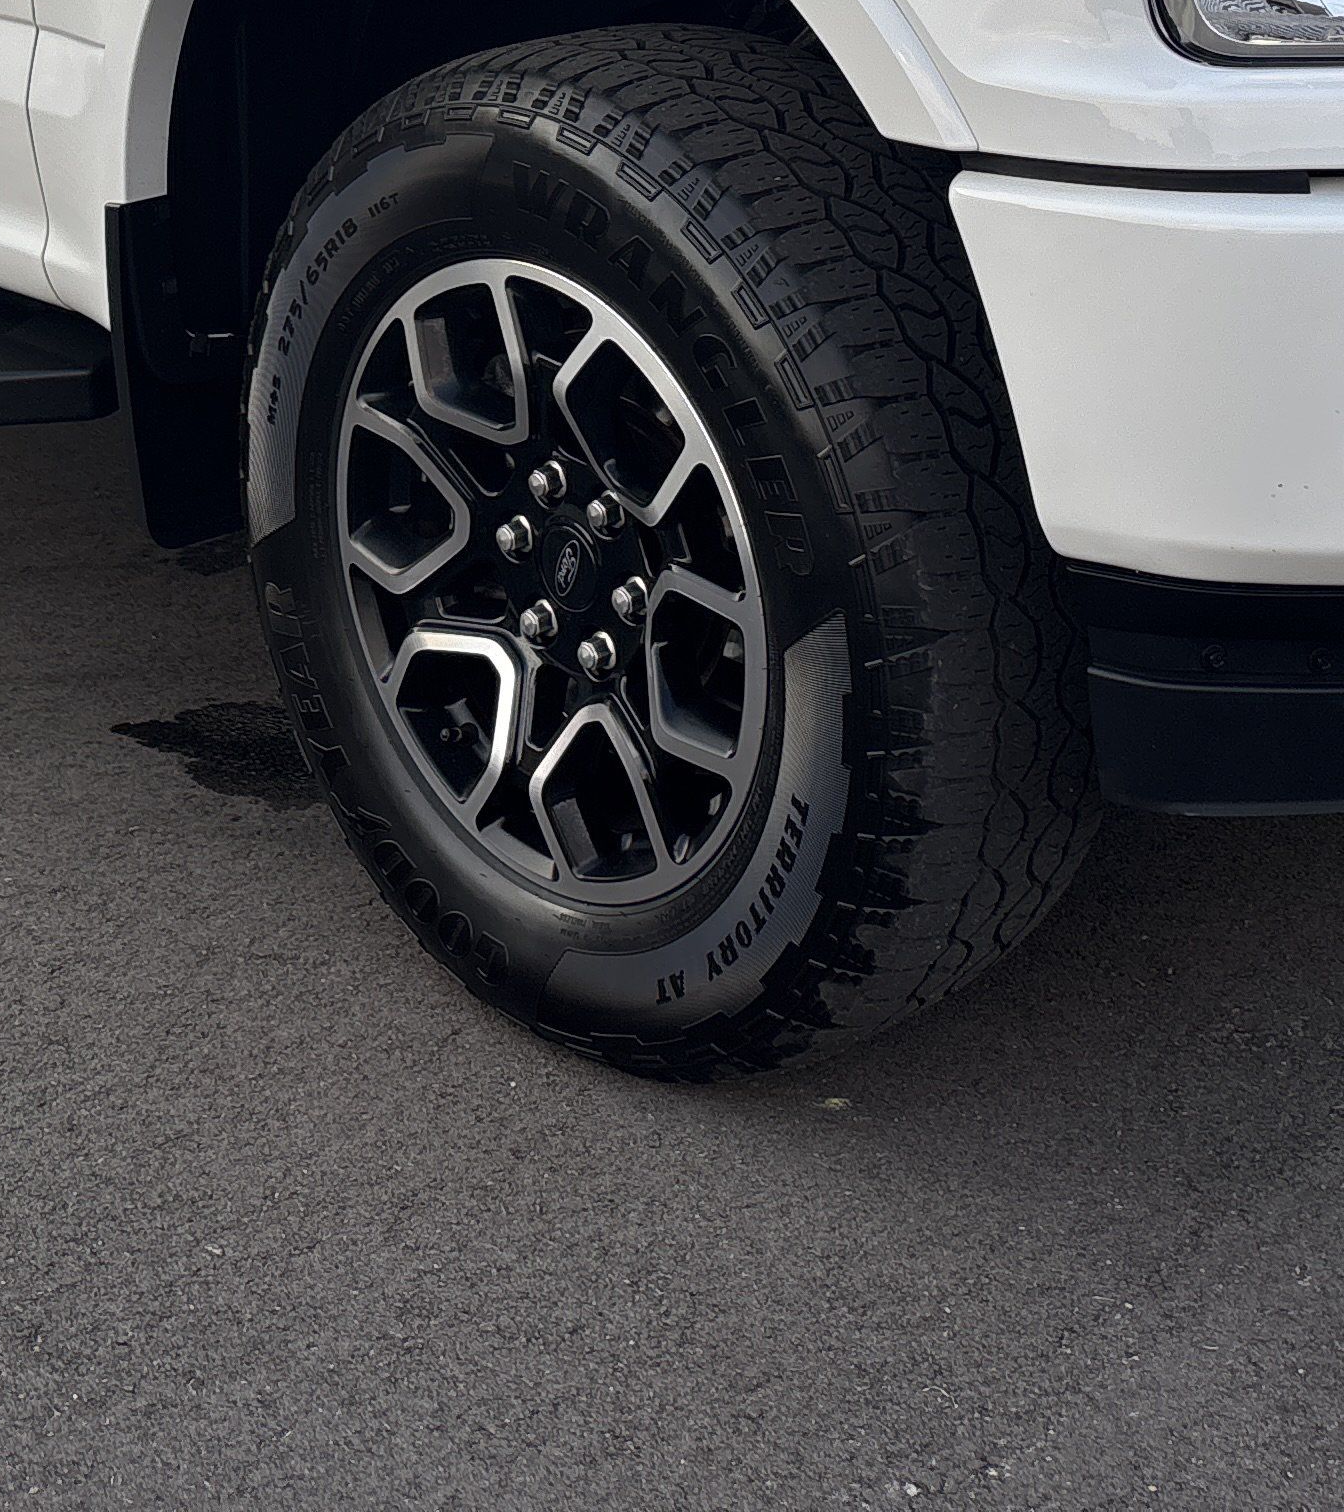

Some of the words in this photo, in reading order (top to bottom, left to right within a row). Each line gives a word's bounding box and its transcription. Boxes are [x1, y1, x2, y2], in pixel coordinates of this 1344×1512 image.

[277, 216, 359, 357] 275/65R18
[367, 192, 399, 219] 116T
[512, 160, 816, 576] WRANGLER
[557, 547, 577, 589] Ford
[706, 792, 810, 982] TERRITORY
[656, 969, 686, 1005] AT
